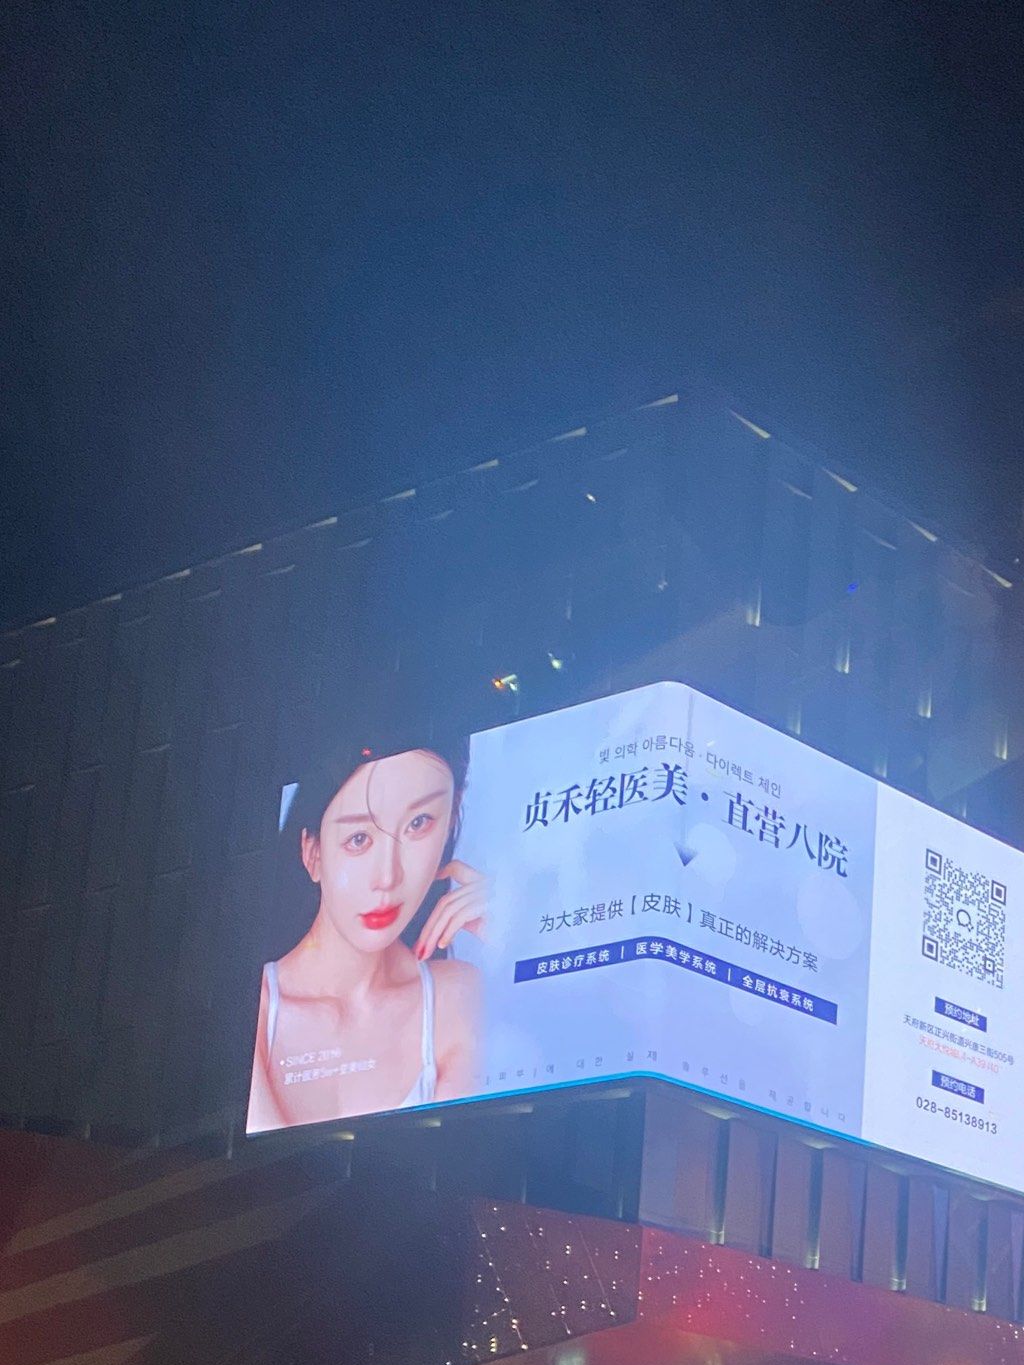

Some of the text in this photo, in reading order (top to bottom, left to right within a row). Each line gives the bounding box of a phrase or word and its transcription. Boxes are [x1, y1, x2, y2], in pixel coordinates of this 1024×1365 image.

[642, 735, 694, 758] 아름다움
[706, 752, 754, 785] 다이렉트
[758, 776, 782, 799] 체인
[536, 941, 815, 1011] 皮肤诊疗系统 医学美学系统 全层抗衰系统
[940, 1075, 976, 1098] 预约电话
[916, 1096, 997, 1135] 028-85138913
